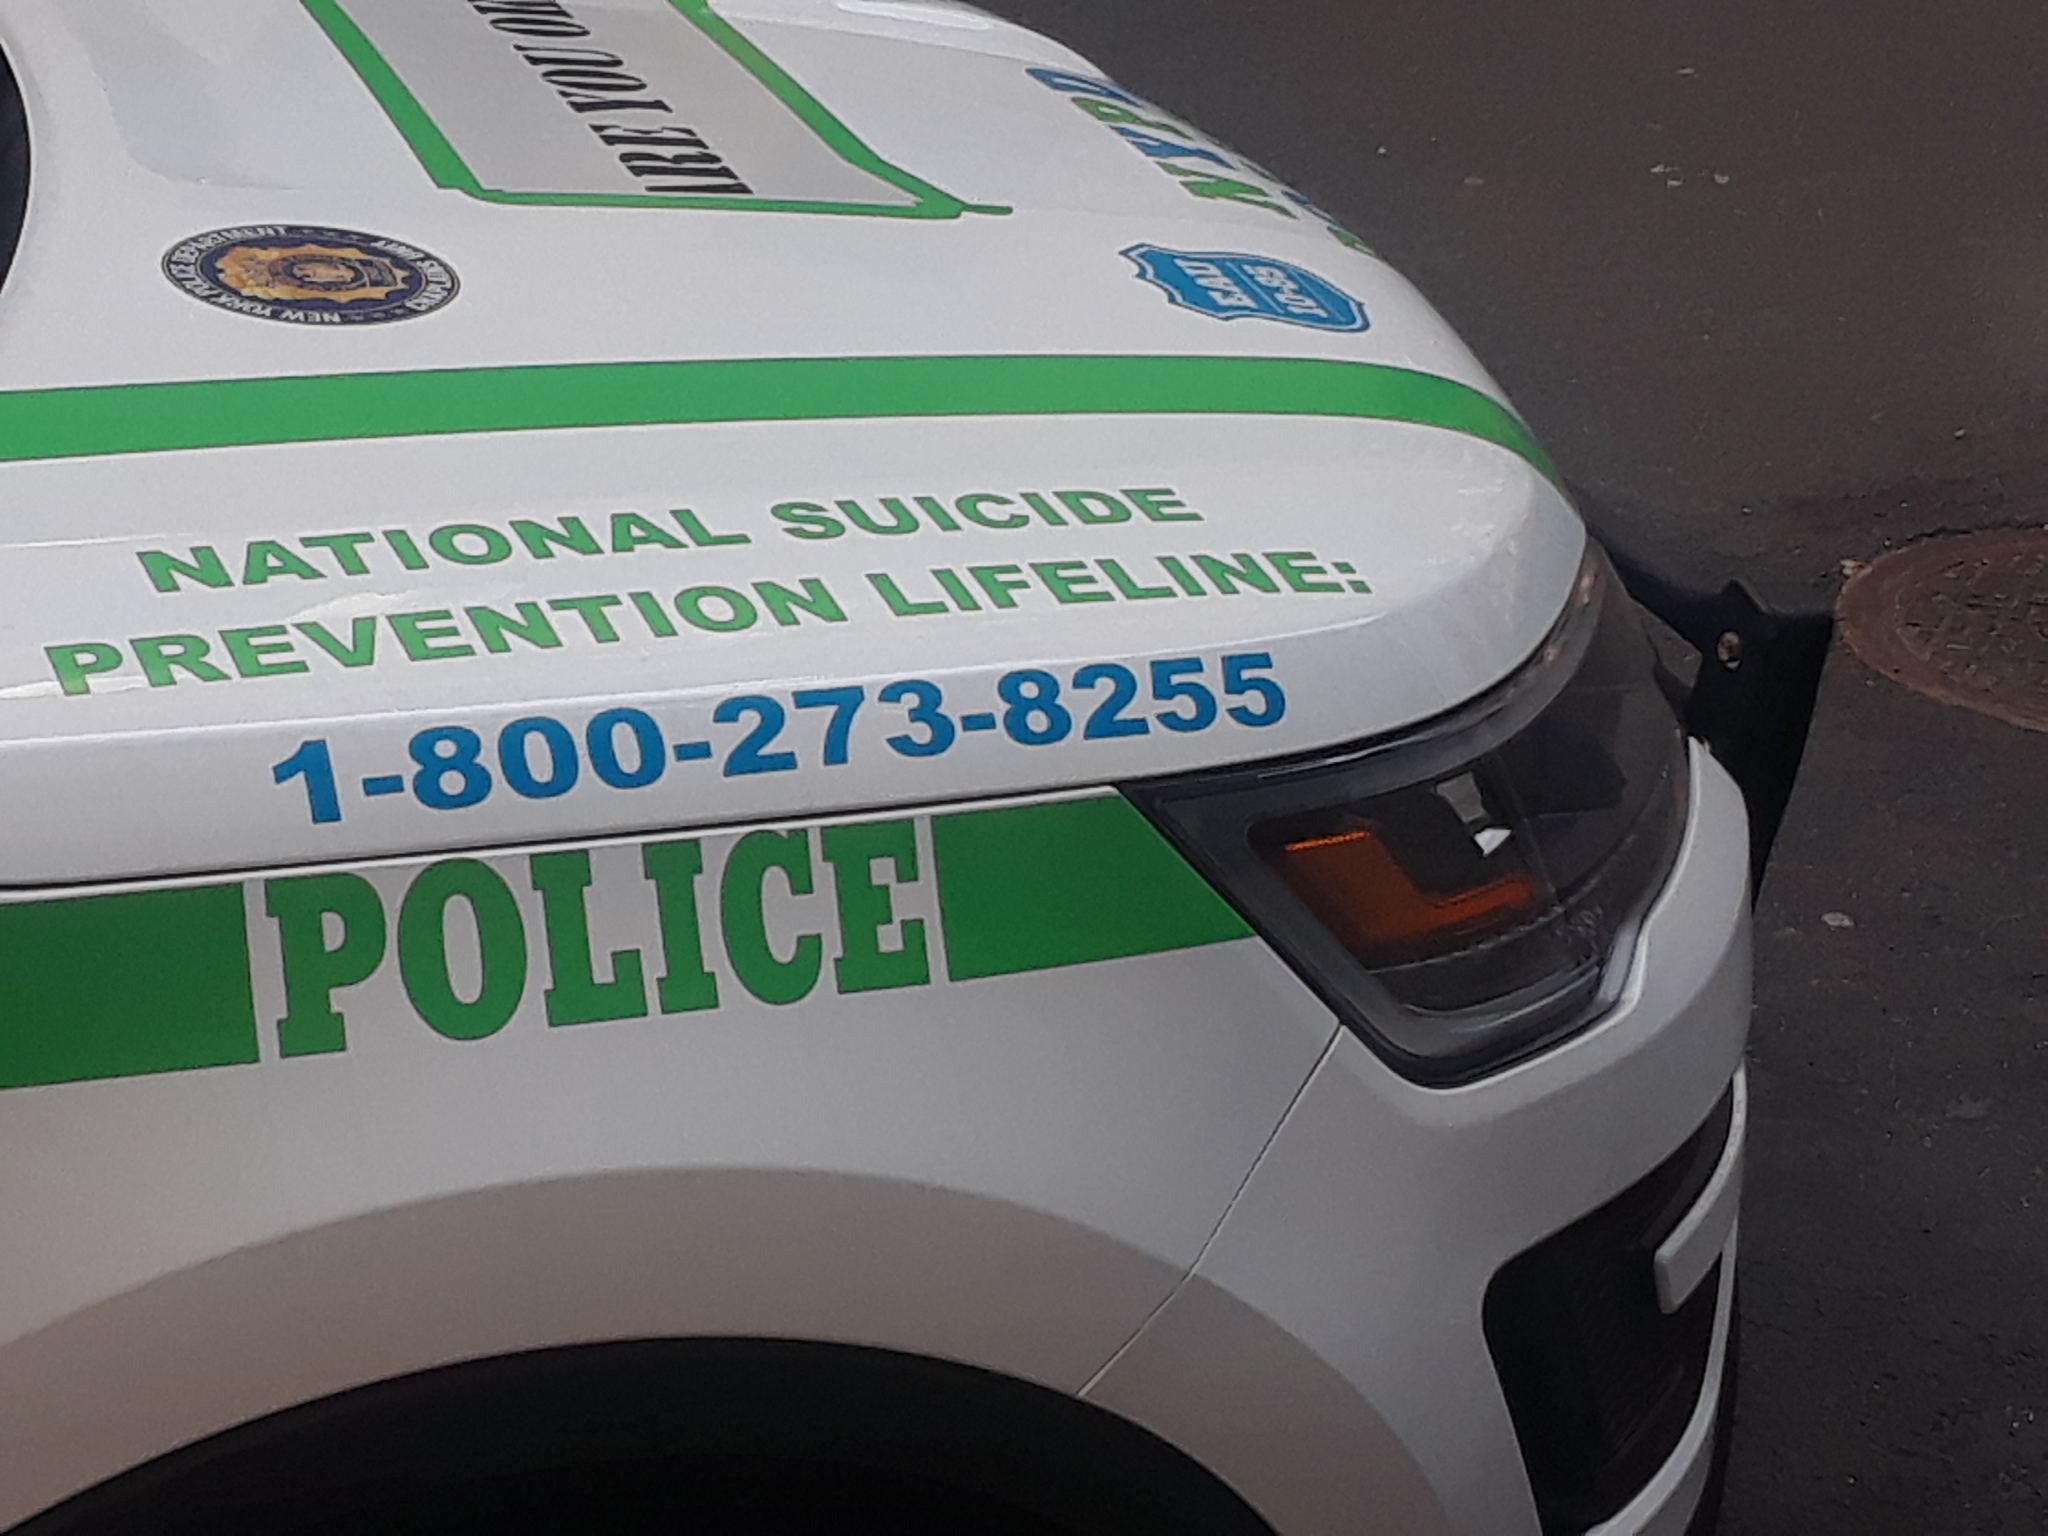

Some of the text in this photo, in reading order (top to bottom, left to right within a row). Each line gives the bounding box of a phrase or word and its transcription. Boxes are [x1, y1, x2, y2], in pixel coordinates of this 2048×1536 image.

[513, 44, 673, 113] YOU
[1025, 68, 1299, 219] NYPD
[135, 487, 1204, 593] NATIONAL SUICIDE
[43, 551, 1373, 697] PREVENTION LIFELINE:
[272, 652, 1287, 824] 1-800-273-8255
[264, 820, 930, 1059] POLICE
